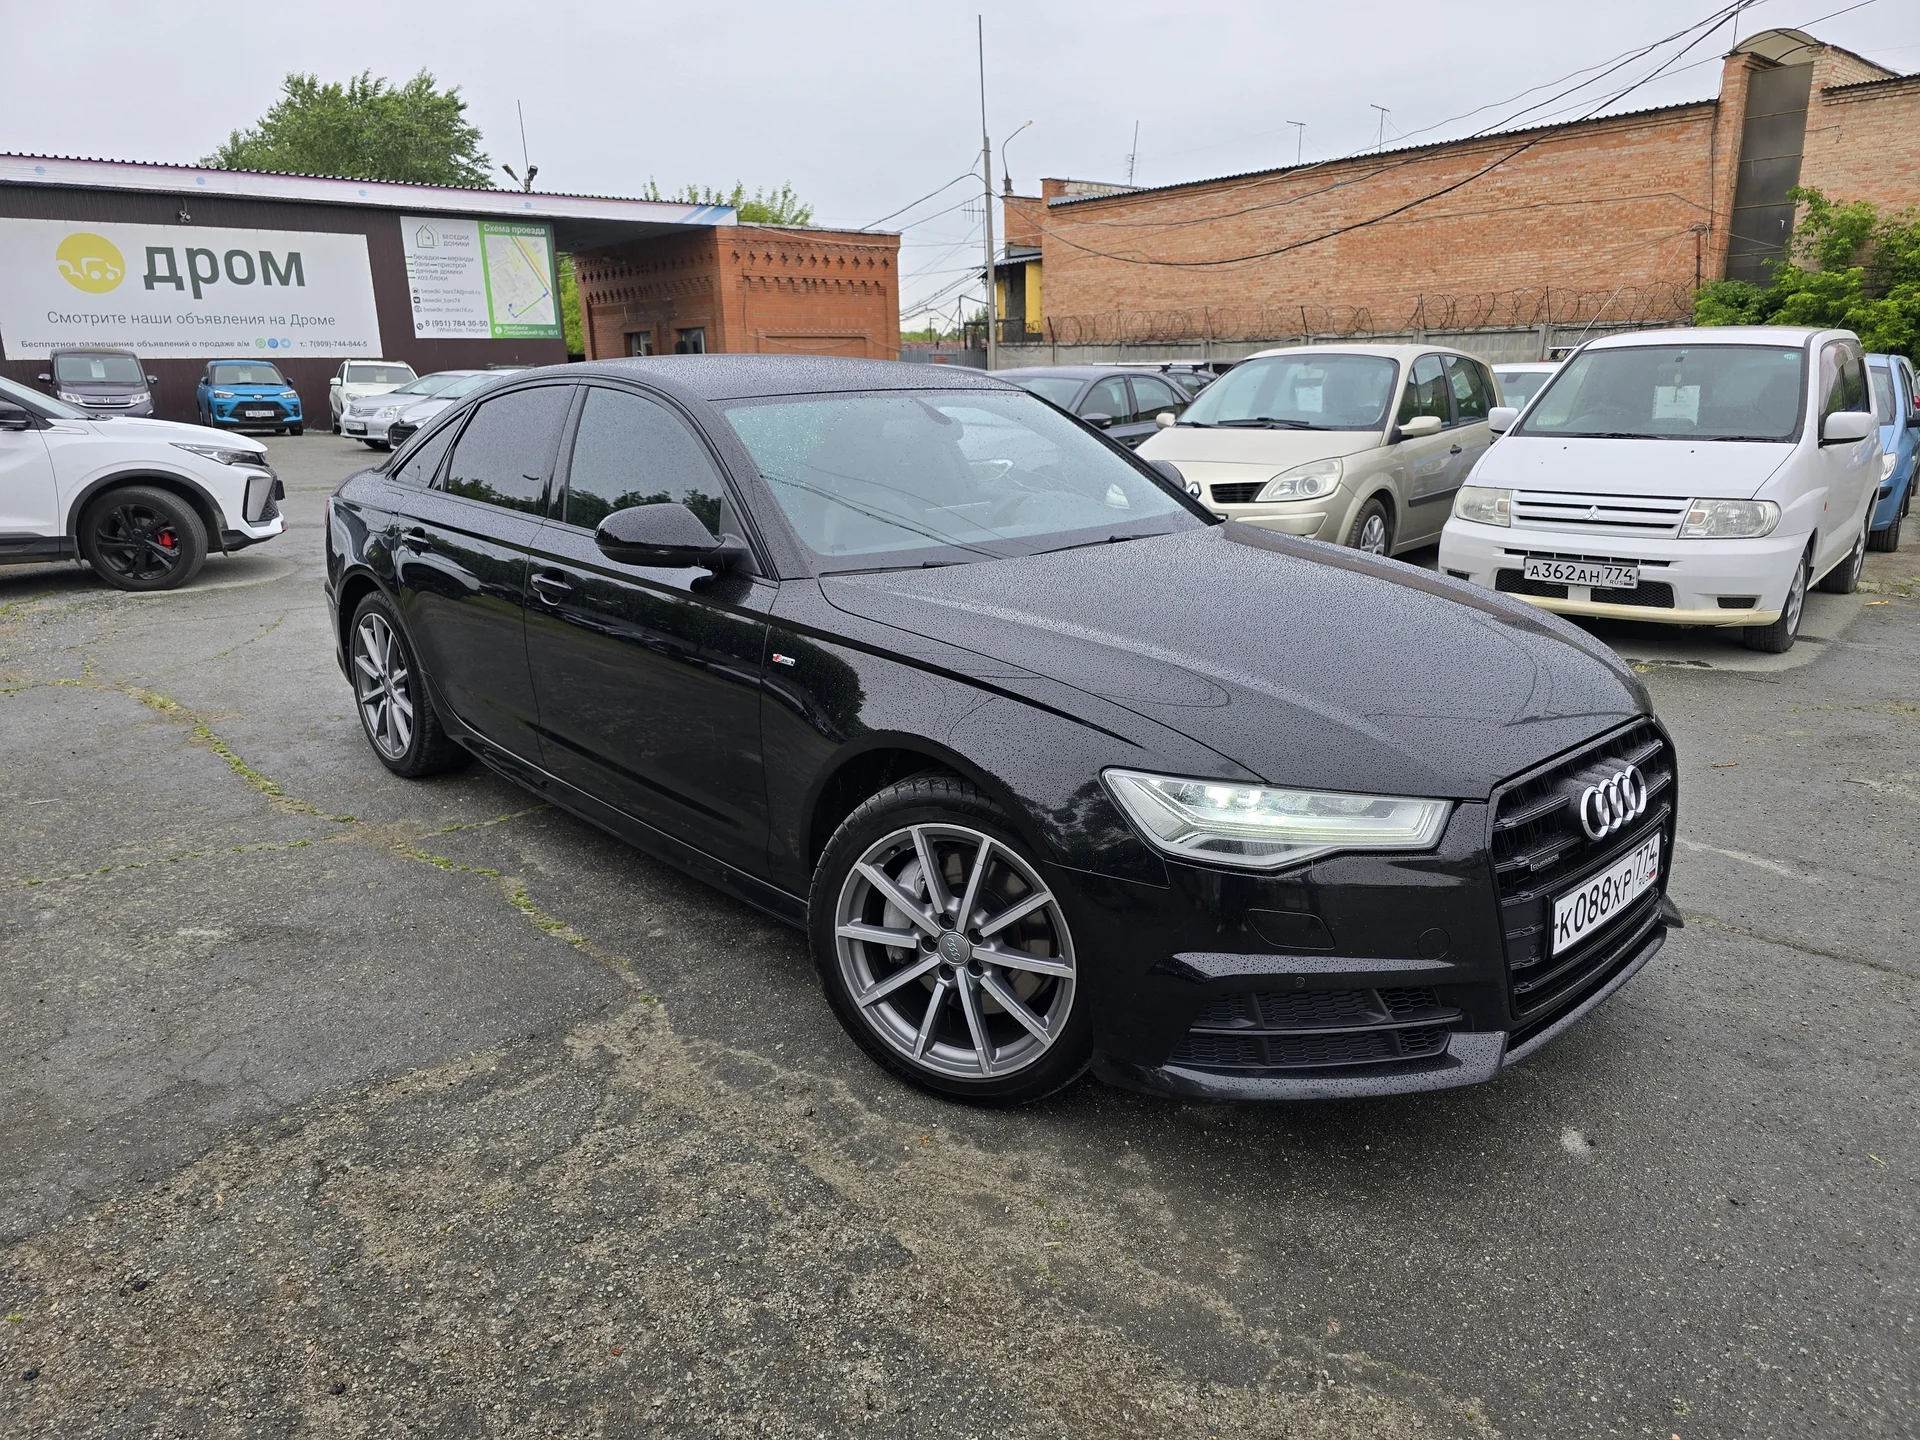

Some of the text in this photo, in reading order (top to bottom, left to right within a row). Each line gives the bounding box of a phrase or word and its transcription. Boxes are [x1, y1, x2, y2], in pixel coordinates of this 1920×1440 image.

[484, 224, 546, 235] Схема проезда
[142, 246, 306, 300] дром
[47, 311, 336, 328] Смотрите наши объявления на Дроме
[136, 340, 190, 348] объявлений
[1530, 563, 1633, 583] А362АН 774
[1559, 838, 1656, 944] К088ХР 774
